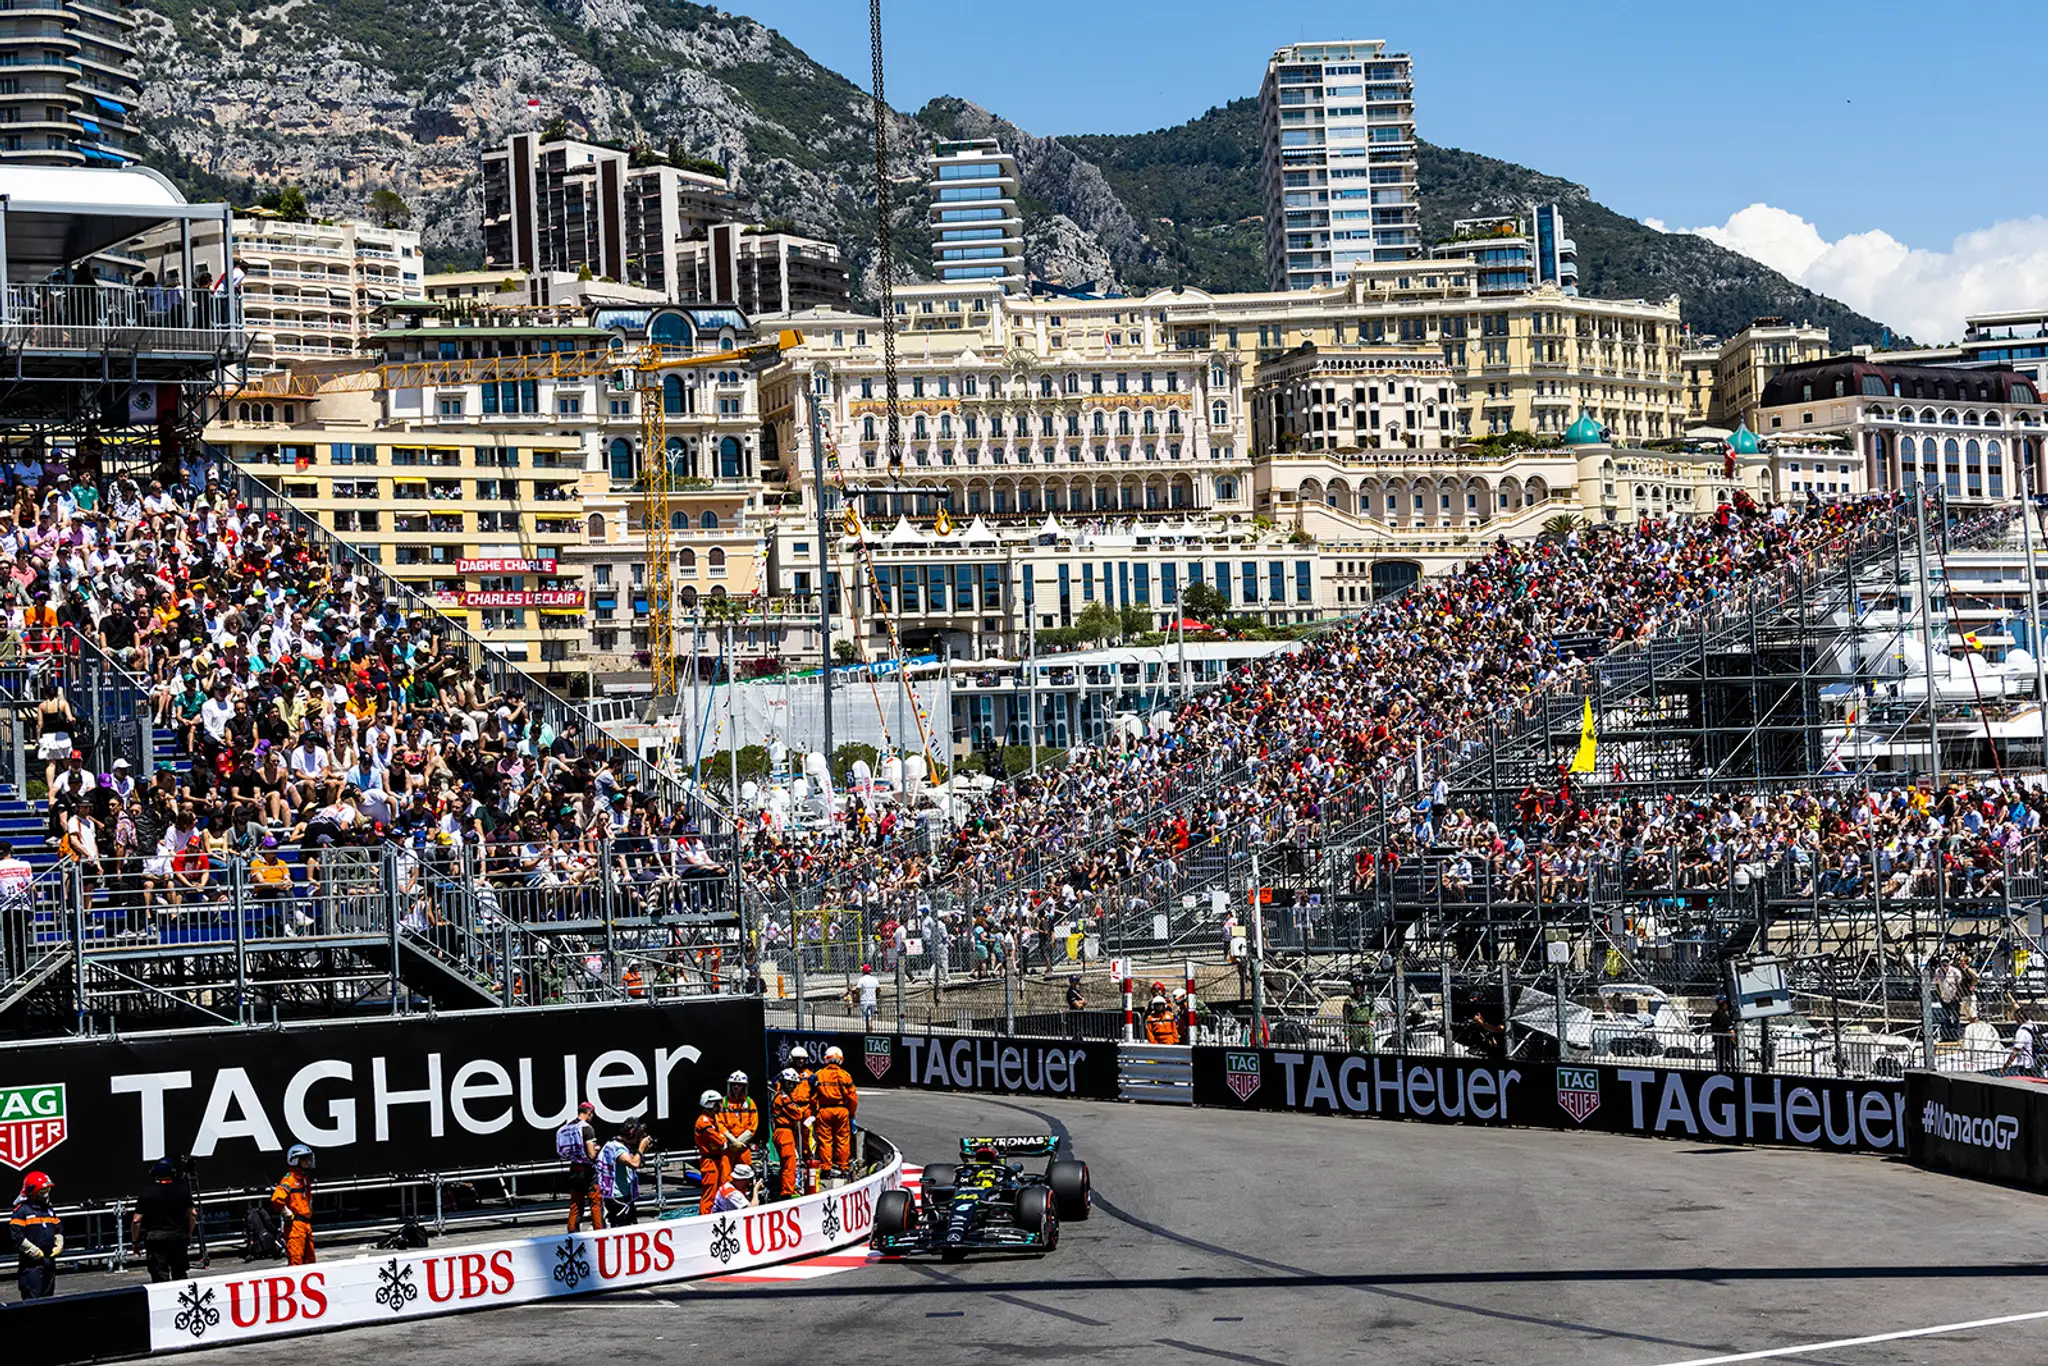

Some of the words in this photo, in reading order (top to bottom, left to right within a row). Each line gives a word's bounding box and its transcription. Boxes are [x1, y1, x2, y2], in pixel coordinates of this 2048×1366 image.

[459, 560, 501, 572] DAGHE
[504, 559, 553, 572] CHARLIE
[467, 592, 523, 605] CHARLES
[525, 592, 576, 605] L'ECLAIR
[867, 1039, 889, 1053] TAG
[867, 1055, 891, 1077] HEUER
[1229, 1055, 1257, 1071] TAG
[1228, 1074, 1259, 1097] HEUER
[1560, 1071, 1596, 1089] TAG
[1560, 1092, 1598, 1118] HEUER
[1921, 1100, 2019, 1151] #MonacoGP
[840, 1186, 872, 1234] UBS
[743, 1206, 803, 1256] UBS
[594, 1228, 675, 1279] UBS
[423, 1250, 515, 1303] UBS
[225, 1272, 328, 1328] UBS
